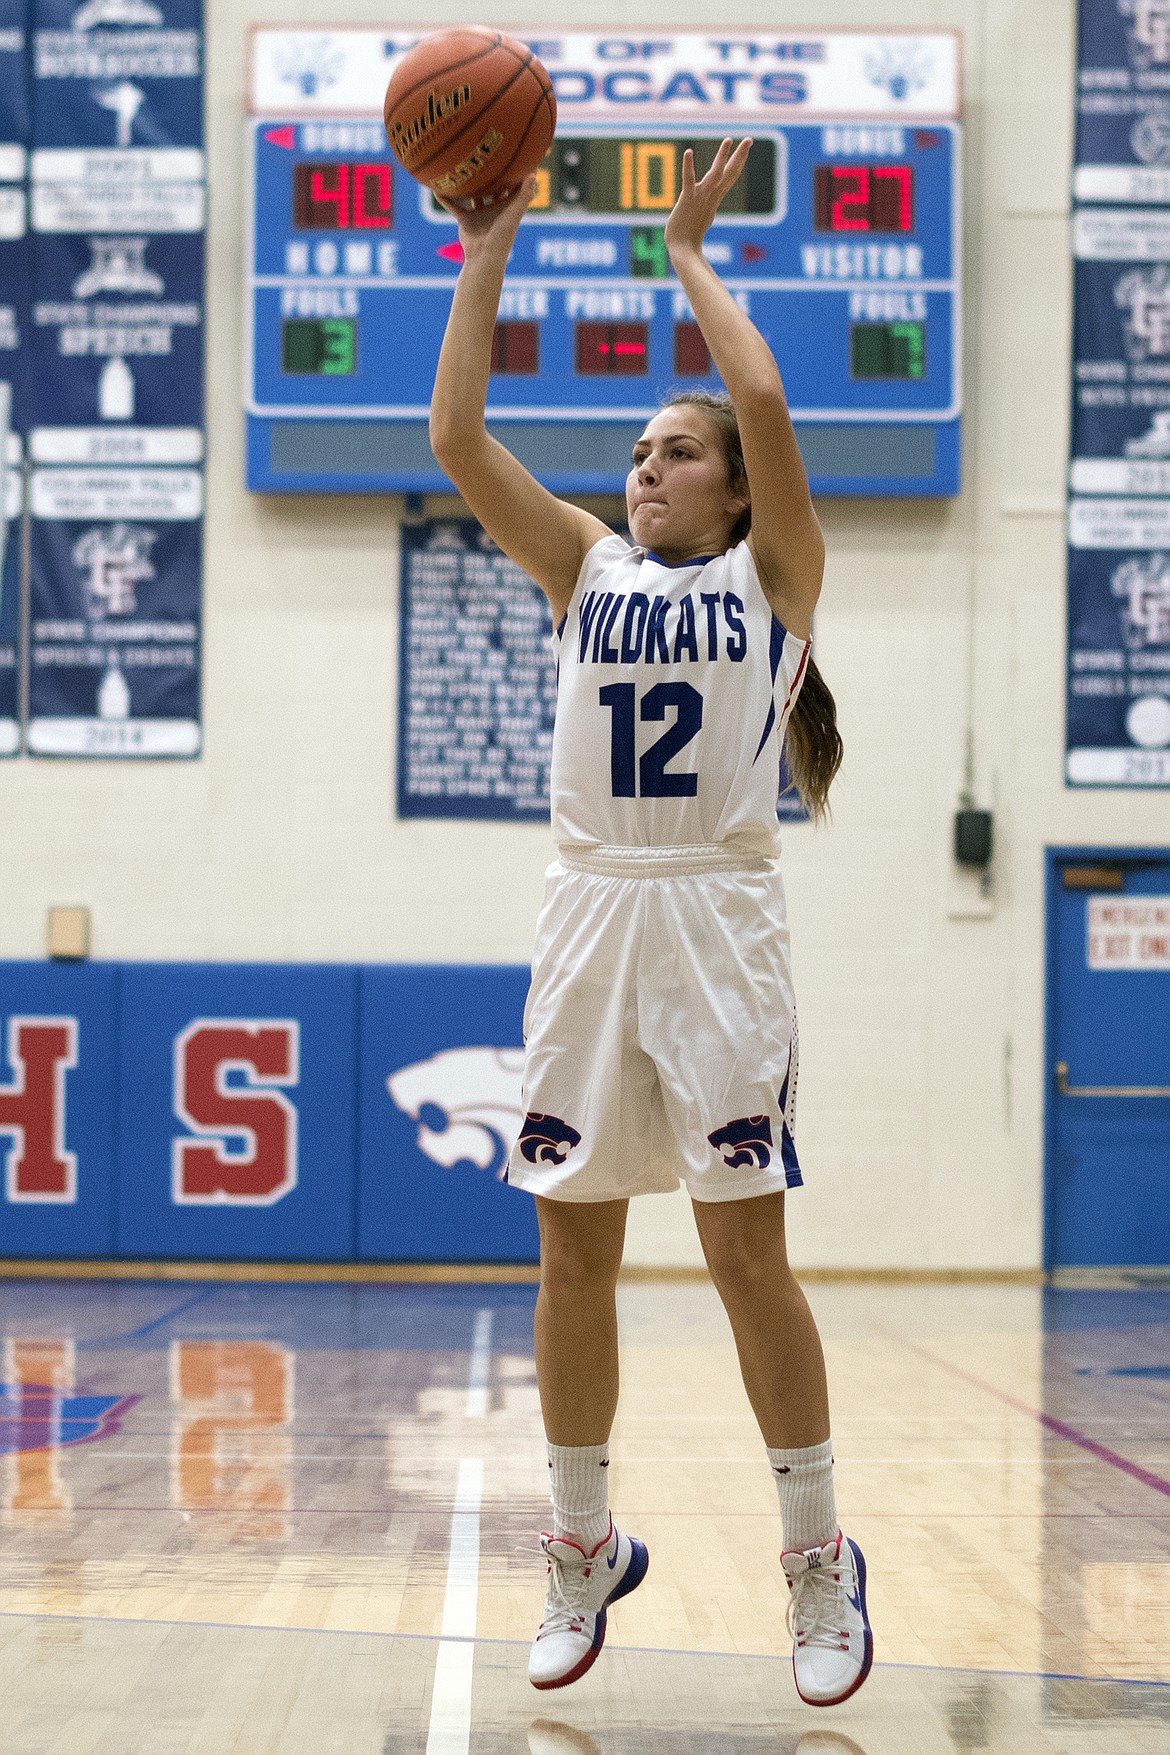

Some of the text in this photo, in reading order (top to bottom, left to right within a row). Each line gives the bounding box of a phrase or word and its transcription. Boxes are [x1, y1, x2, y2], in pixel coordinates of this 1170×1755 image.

[597, 39, 674, 61] OF
[707, 40, 827, 62] THE
[552, 69, 808, 105] DCATS
[390, 83, 471, 162] Baden
[311, 164, 391, 229] 40
[831, 166, 912, 232] 27
[286, 240, 400, 275] HOME
[537, 240, 617, 267] PERIOD
[630, 226, 668, 279] 4
[802, 242, 923, 277] VISITOR
[282, 288, 359, 318] FOULS
[566, 289, 656, 319] POINTS
[849, 291, 927, 320] FOULS
[321, 318, 354, 375] 3
[891, 323, 923, 379] 7
[577, 590, 747, 663] WILDKATS
[599, 681, 703, 798] 12
